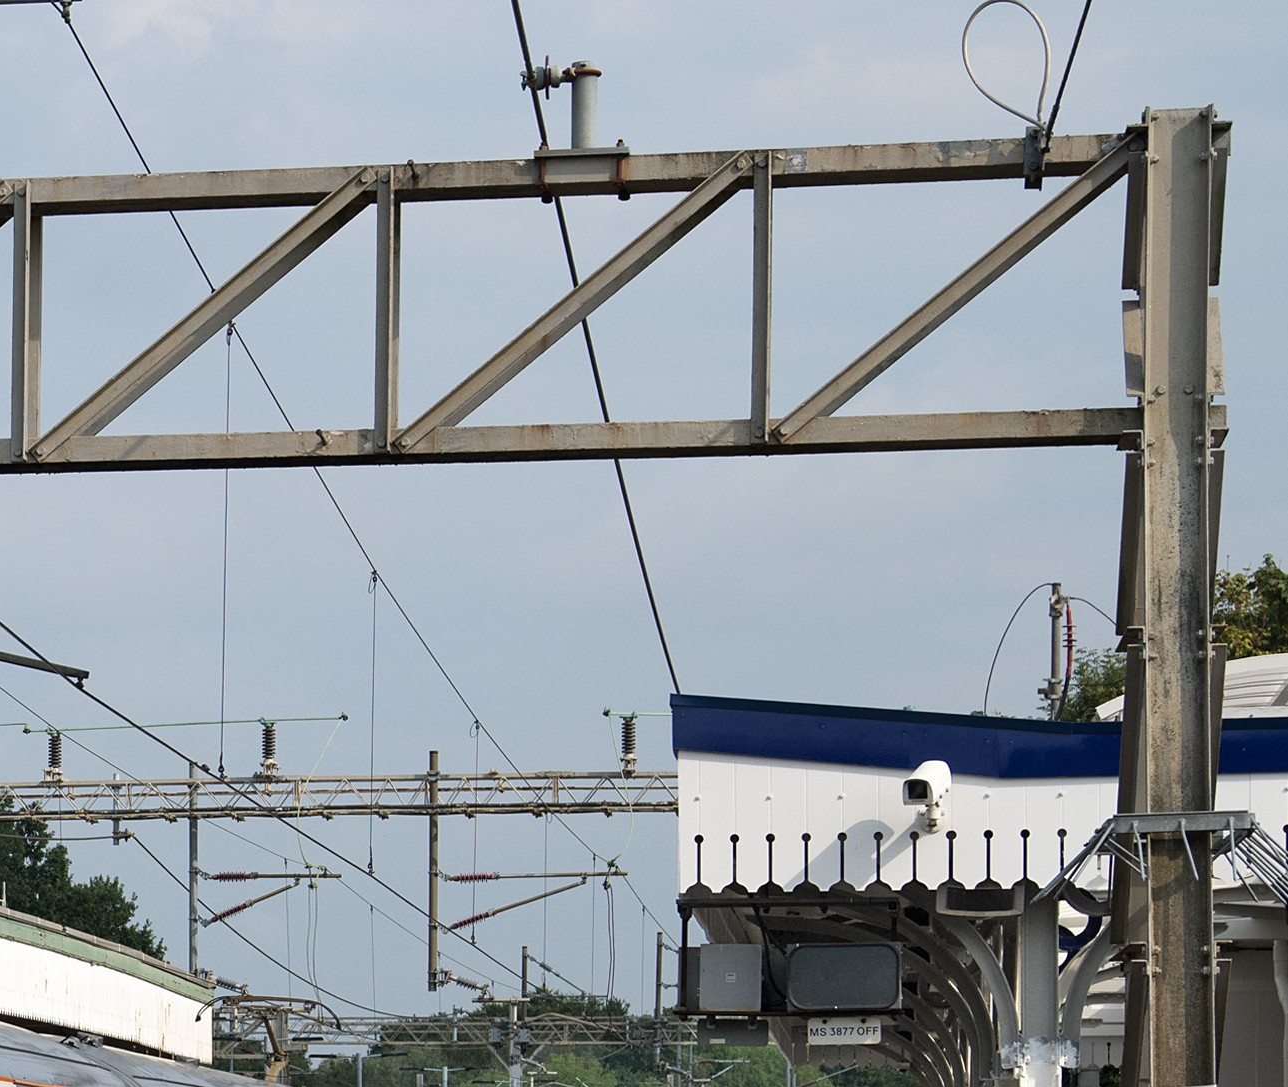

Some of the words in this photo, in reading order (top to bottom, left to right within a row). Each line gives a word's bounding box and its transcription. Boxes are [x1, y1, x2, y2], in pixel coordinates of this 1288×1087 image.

[809, 1026, 827, 1038] MS
[829, 1026, 855, 1038] 3877
[856, 1025, 880, 1037] OFF
